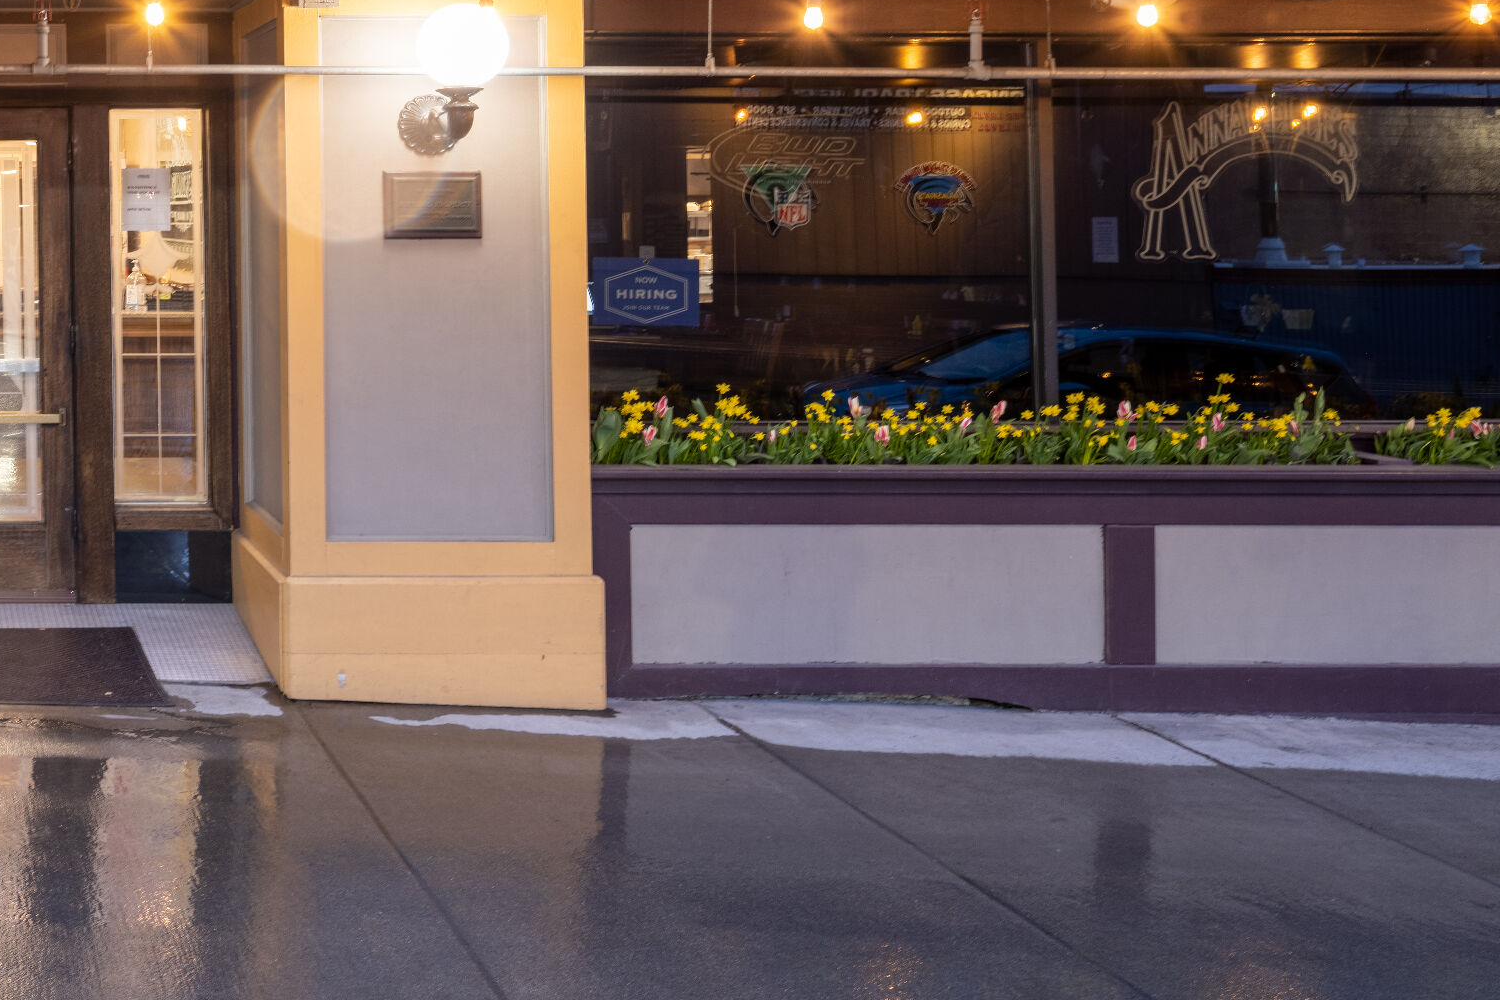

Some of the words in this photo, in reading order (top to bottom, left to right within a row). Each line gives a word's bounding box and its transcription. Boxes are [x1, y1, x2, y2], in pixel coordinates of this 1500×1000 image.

[747, 132, 858, 157] BUD
[723, 151, 867, 177] LIGHT
[777, 202, 807, 224] NFL
[634, 276, 658, 284] NOW
[615, 289, 678, 300] HIRING
